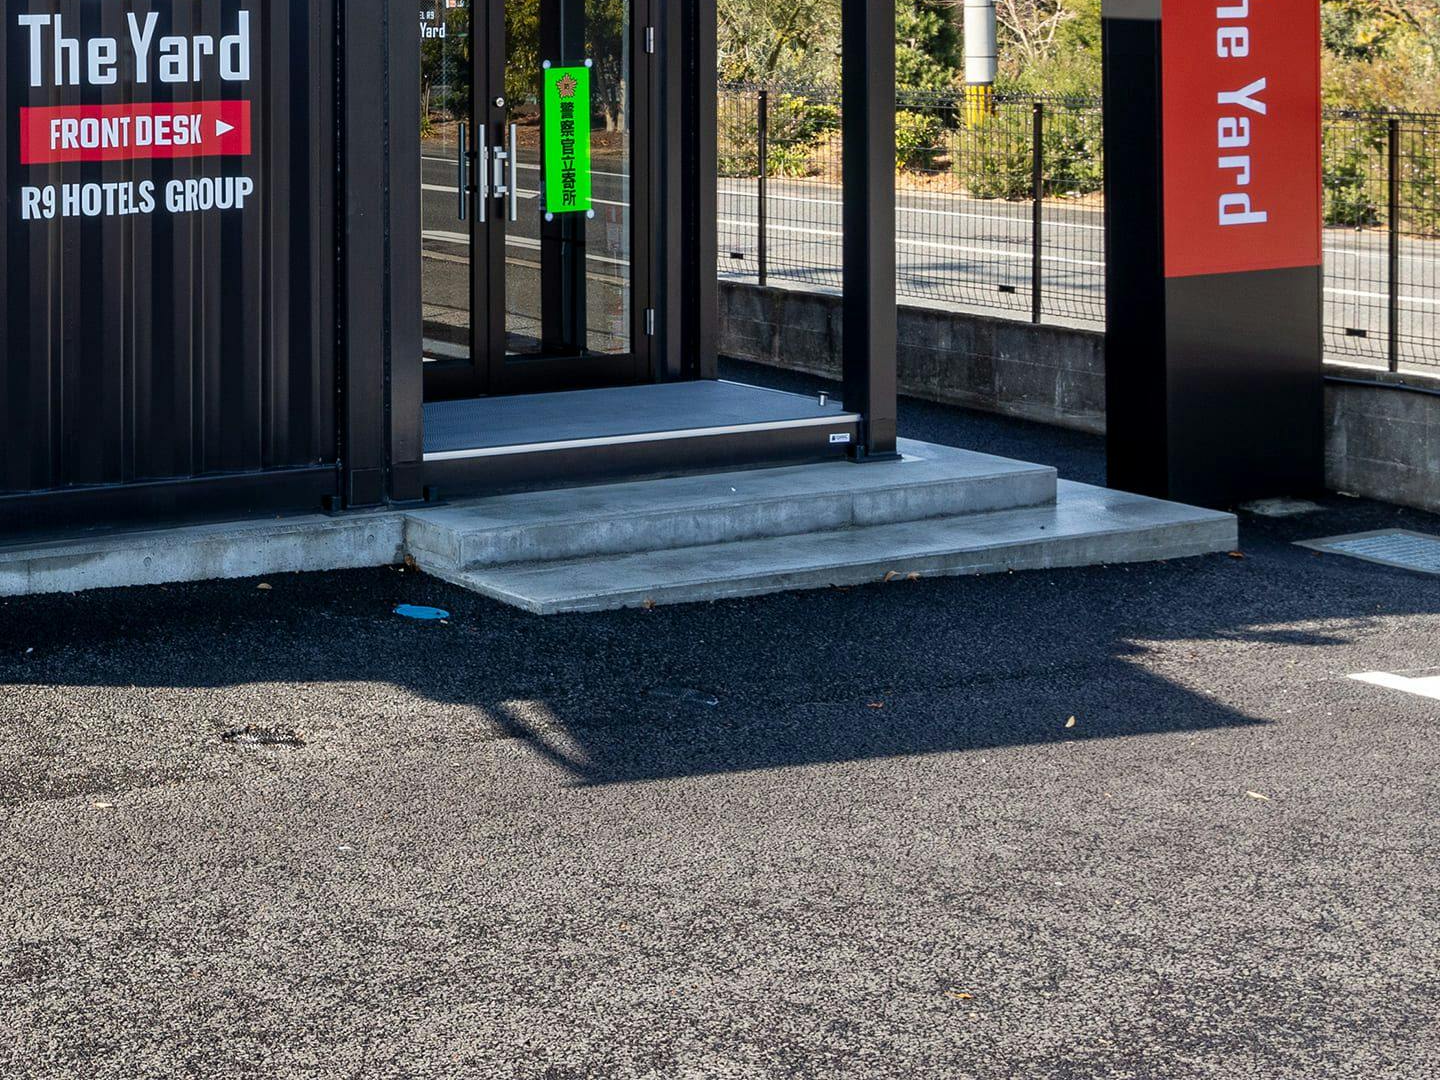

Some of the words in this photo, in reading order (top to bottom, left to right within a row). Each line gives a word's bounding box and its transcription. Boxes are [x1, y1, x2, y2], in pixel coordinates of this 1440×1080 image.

[419, 22, 446, 38] Yard
[50, 116, 131, 150] FRONT
[135, 114, 203, 146] DESK
[560, 101, 576, 206] 警察官立寄所
[1216, 77, 1268, 226] Yard
[21, 185, 56, 220] R9
[62, 180, 156, 217] HOTELS
[165, 176, 254, 213] GROUP
